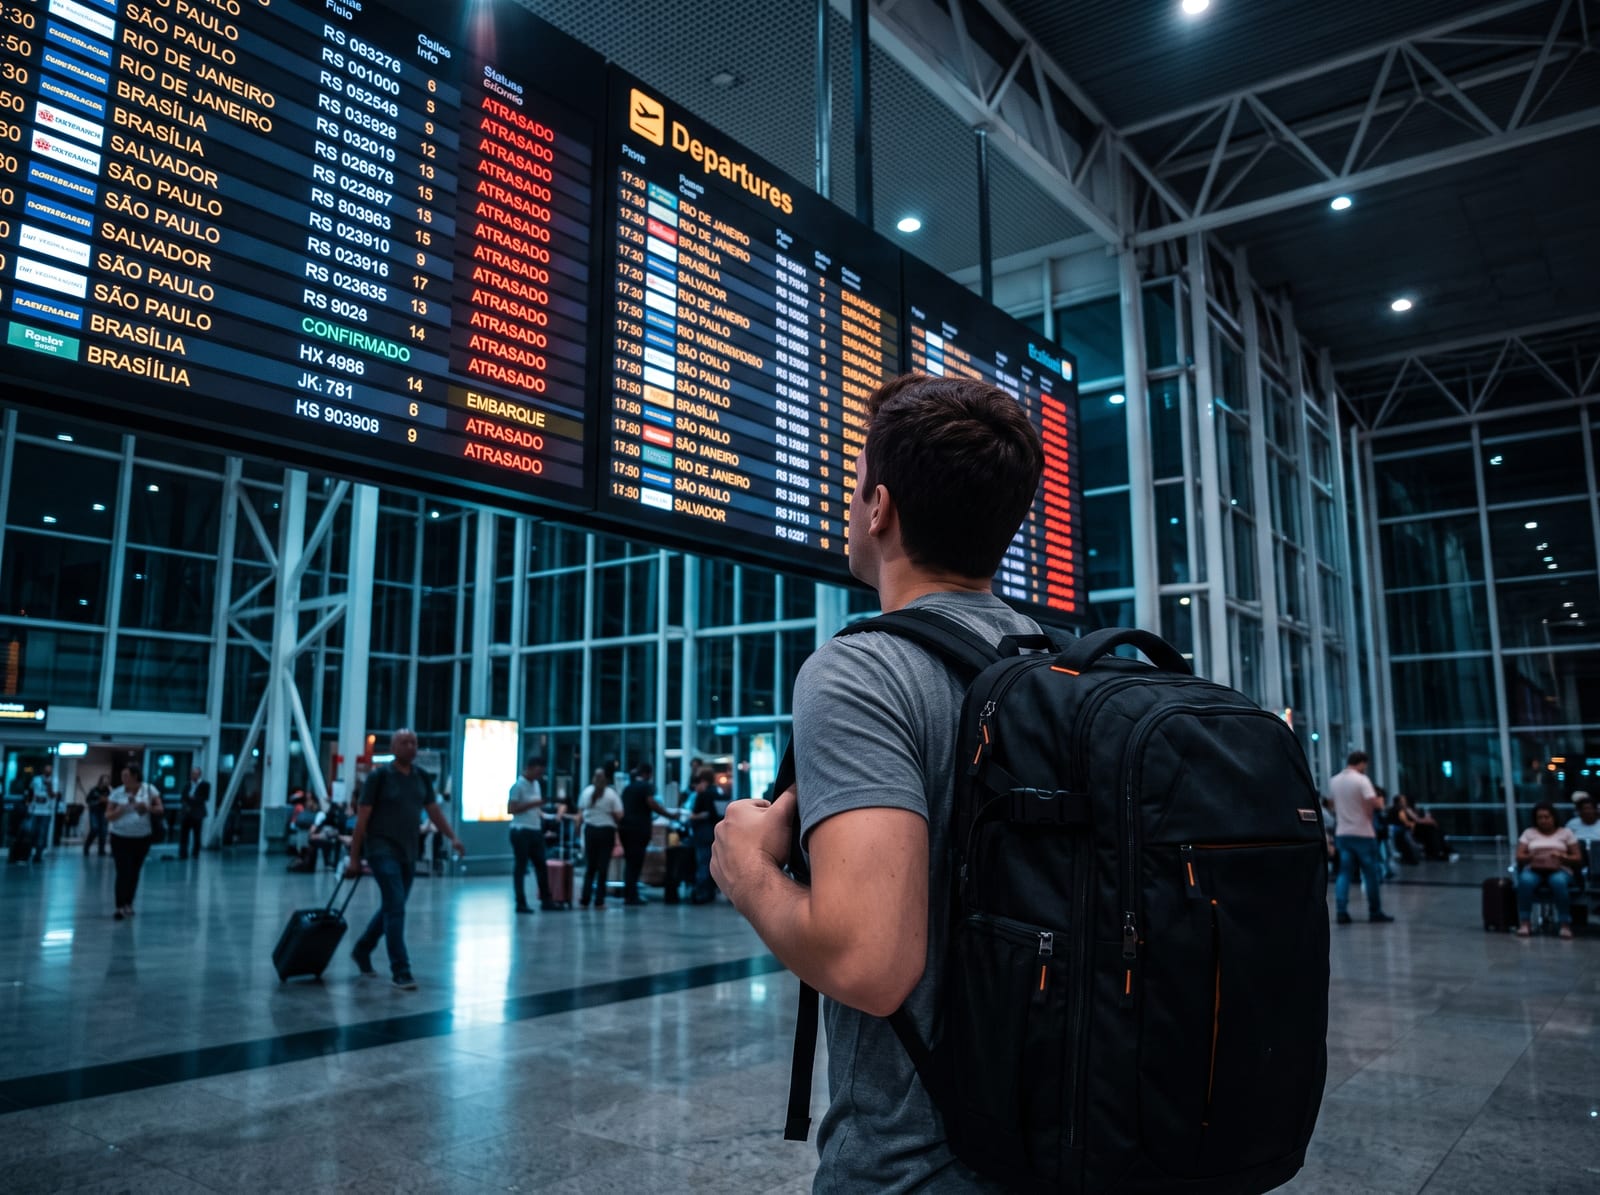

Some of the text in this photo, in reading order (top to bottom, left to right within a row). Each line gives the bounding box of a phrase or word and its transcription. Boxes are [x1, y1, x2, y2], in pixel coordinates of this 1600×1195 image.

[126, 4, 168, 33] SÃO
[173, 25, 236, 65] PAULO
[324, 24, 346, 45] RS
[123, 28, 159, 56] RIO
[165, 47, 191, 72] DE
[196, 64, 275, 108] JANEIRO
[320, 70, 343, 92] RS
[322, 47, 400, 95] RS 001000
[117, 80, 207, 132] BRASÍLIA
[120, 54, 156, 81] RIO
[161, 72, 188, 97] DE
[192, 89, 272, 132] JANEIRO
[318, 93, 341, 114] RS
[114, 107, 204, 157] BRASÍLIA
[425, 122, 434, 135] 9
[482, 97, 554, 142] ATRASADO
[315, 140, 338, 161] RS
[316, 116, 396, 162] RS 032019
[421, 142, 436, 158] 12
[480, 118, 553, 162] ATRASADO
[111, 135, 218, 189] SALVADOR
[313, 164, 336, 185] RS
[419, 164, 434, 179] 13
[479, 138, 552, 182] ATRASADO
[672, 121, 793, 214] Departures
[108, 162, 152, 190] SÃO
[157, 180, 222, 216] PAULO
[418, 185, 433, 201] 15
[478, 159, 551, 202] ATRASADO
[621, 171, 646, 190] 17:30
[311, 187, 391, 230] RS 803963
[477, 180, 551, 222] ATRASADO
[105, 192, 149, 219] SÃO
[155, 208, 220, 243] PAULO
[309, 211, 390, 253] RS 023910
[476, 202, 550, 243] ATRASADO
[679, 200, 750, 246] RIO DE JANEIRO
[101, 222, 211, 272] SALVADOR
[415, 230, 431, 245] 15
[475, 223, 550, 263] ATRASADO
[619, 244, 644, 263] 17:20
[678, 235, 721, 265] BRASÍLIA
[679, 218, 751, 263] RIO DE JANEIRO
[307, 236, 389, 277] RS 023916
[416, 253, 426, 266] 9
[474, 245, 549, 284] ATRASADO
[618, 263, 643, 281] 17:20
[678, 253, 721, 282] BRASÍLIA
[97, 253, 142, 279] SÃO
[148, 268, 214, 301] PAULO
[305, 262, 387, 302] RS 023635
[413, 275, 428, 290] 17
[473, 266, 549, 305] ATRASADO
[678, 271, 727, 302] SALVADOR
[94, 284, 139, 310] SÃO
[145, 298, 211, 330] PAULO
[303, 289, 327, 309] RS
[411, 299, 427, 315] 13
[471, 289, 548, 326] ATRASADO
[678, 288, 750, 329] RIO DE JANEIRO
[90, 314, 186, 355] BRASÍLIA
[409, 325, 425, 341] 14
[470, 311, 547, 348] ATRASADO
[677, 306, 731, 338] SÃO PAULO
[677, 324, 695, 340] RIO
[302, 317, 410, 362] CONFIRMADO
[469, 334, 546, 370] ATRASADO
[677, 342, 698, 360] SÃO
[300, 344, 364, 375] HX 4986
[468, 358, 546, 393] ATRASADO
[676, 361, 731, 390] SÃO PAULO
[326, 379, 353, 400] 781
[407, 377, 423, 392] 14
[676, 379, 730, 408] SÃO PAULO
[324, 407, 379, 434] 903908
[467, 392, 545, 428] EMBARQUE
[676, 398, 719, 423] BRASÍLIA
[408, 428, 417, 442] 9
[465, 418, 544, 450] ATRASADO
[675, 437, 697, 453] SÃO
[676, 417, 730, 444] SÃO PAULO
[464, 442, 543, 474] ATRASADO
[675, 457, 750, 489] RIO DE JANEIRO
[675, 478, 730, 503] SÃO PAULO
[775, 487, 788, 501] RS
[674, 498, 726, 522] SALVADOR
[775, 506, 788, 520] RS
[775, 525, 787, 538] RS
